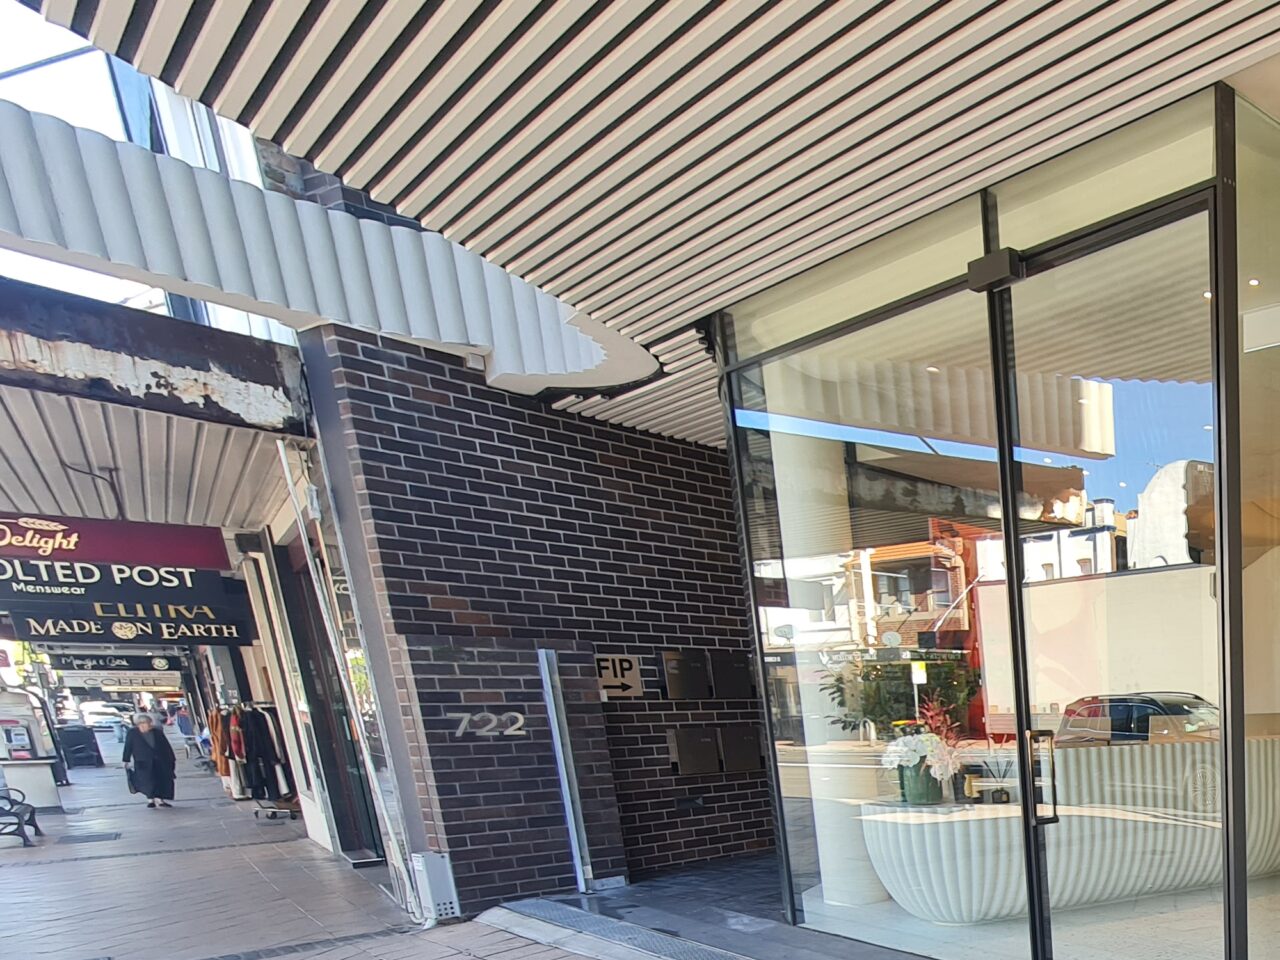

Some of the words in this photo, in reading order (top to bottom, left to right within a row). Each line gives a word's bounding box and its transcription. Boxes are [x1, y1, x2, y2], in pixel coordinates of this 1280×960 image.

[111, 564, 196, 588] POST
[11, 582, 86, 594] Menswear
[26, 618, 104, 636] MADE
[160, 622, 240, 639] EARTH
[596, 658, 633, 679] FIP
[446, 712, 527, 738] 722
